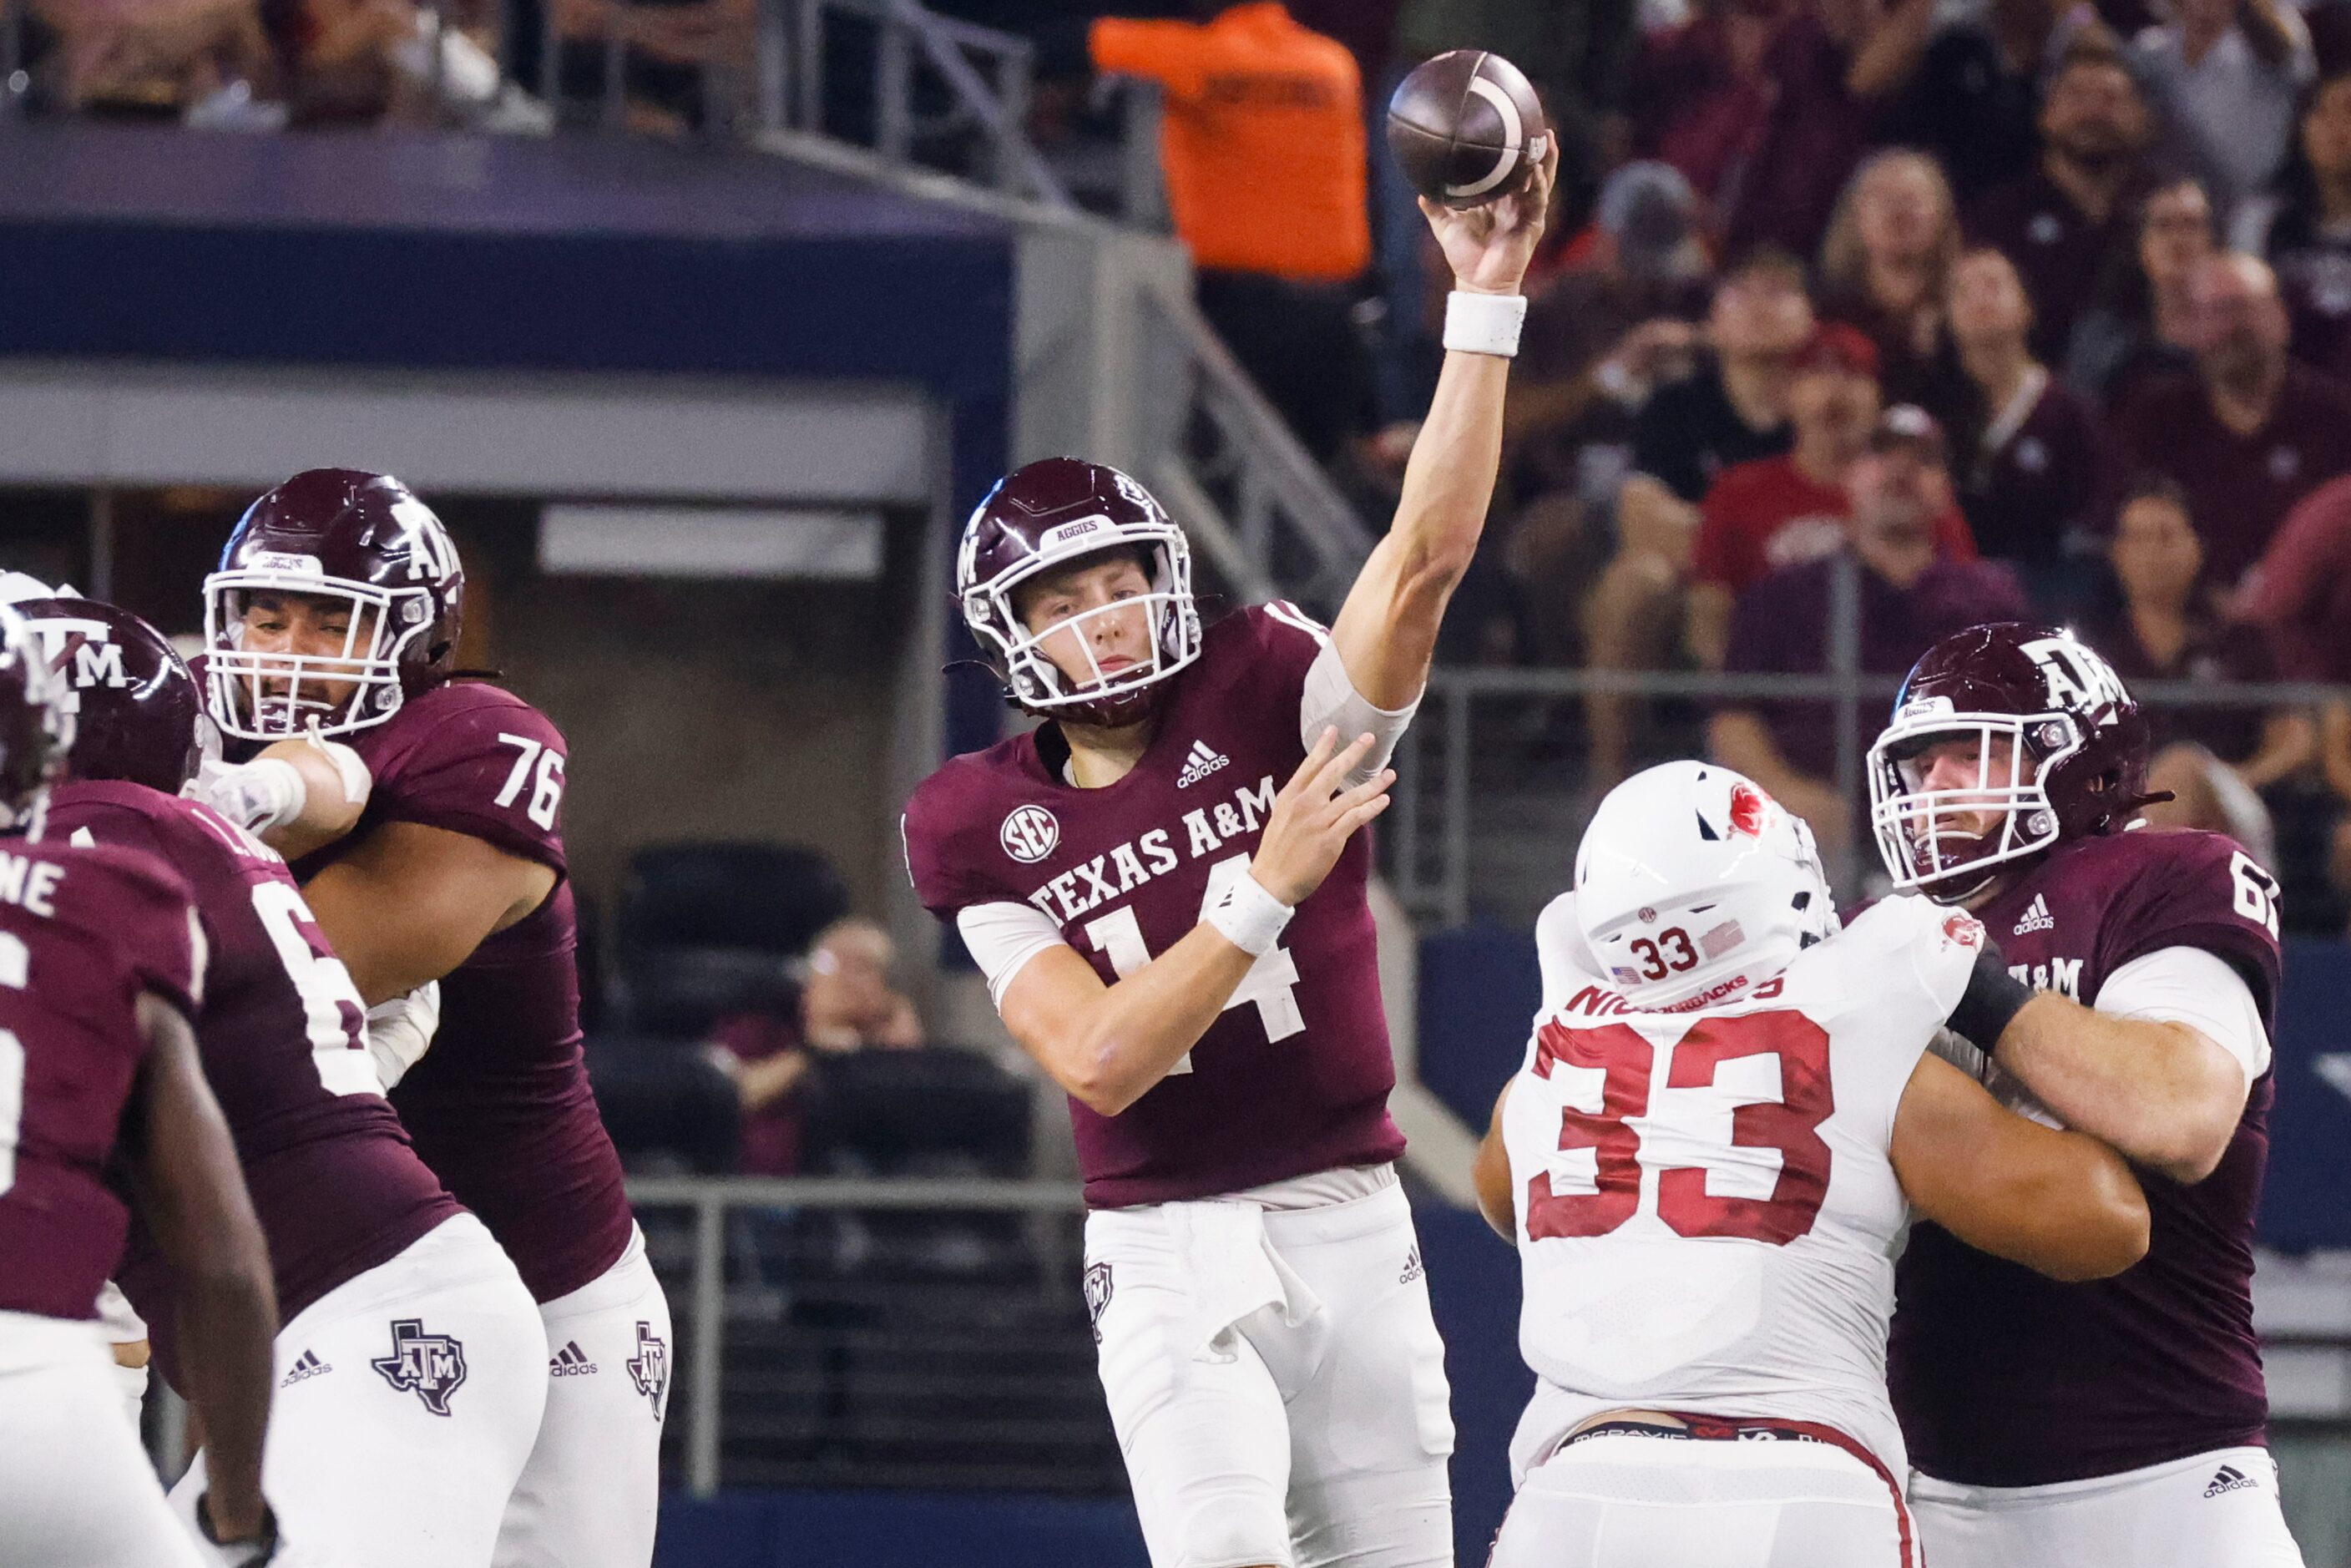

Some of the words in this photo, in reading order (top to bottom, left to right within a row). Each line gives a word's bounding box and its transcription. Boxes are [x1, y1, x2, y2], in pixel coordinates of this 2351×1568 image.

[1056, 520, 1098, 541] AGGIES
[493, 731, 565, 832] 76
[1176, 753, 1231, 789] adidas
[1004, 808, 1055, 859] SEC
[1028, 827, 1178, 929] TEXAS
[1181, 775, 1277, 858] A&M
[2013, 916, 2055, 935] adidas
[1084, 852, 1307, 1075] 14
[1630, 926, 1699, 981] 33
[1525, 1009, 1835, 1246] 33
[550, 1362, 598, 1377] didas
[2203, 1479, 2259, 1499] adidas
